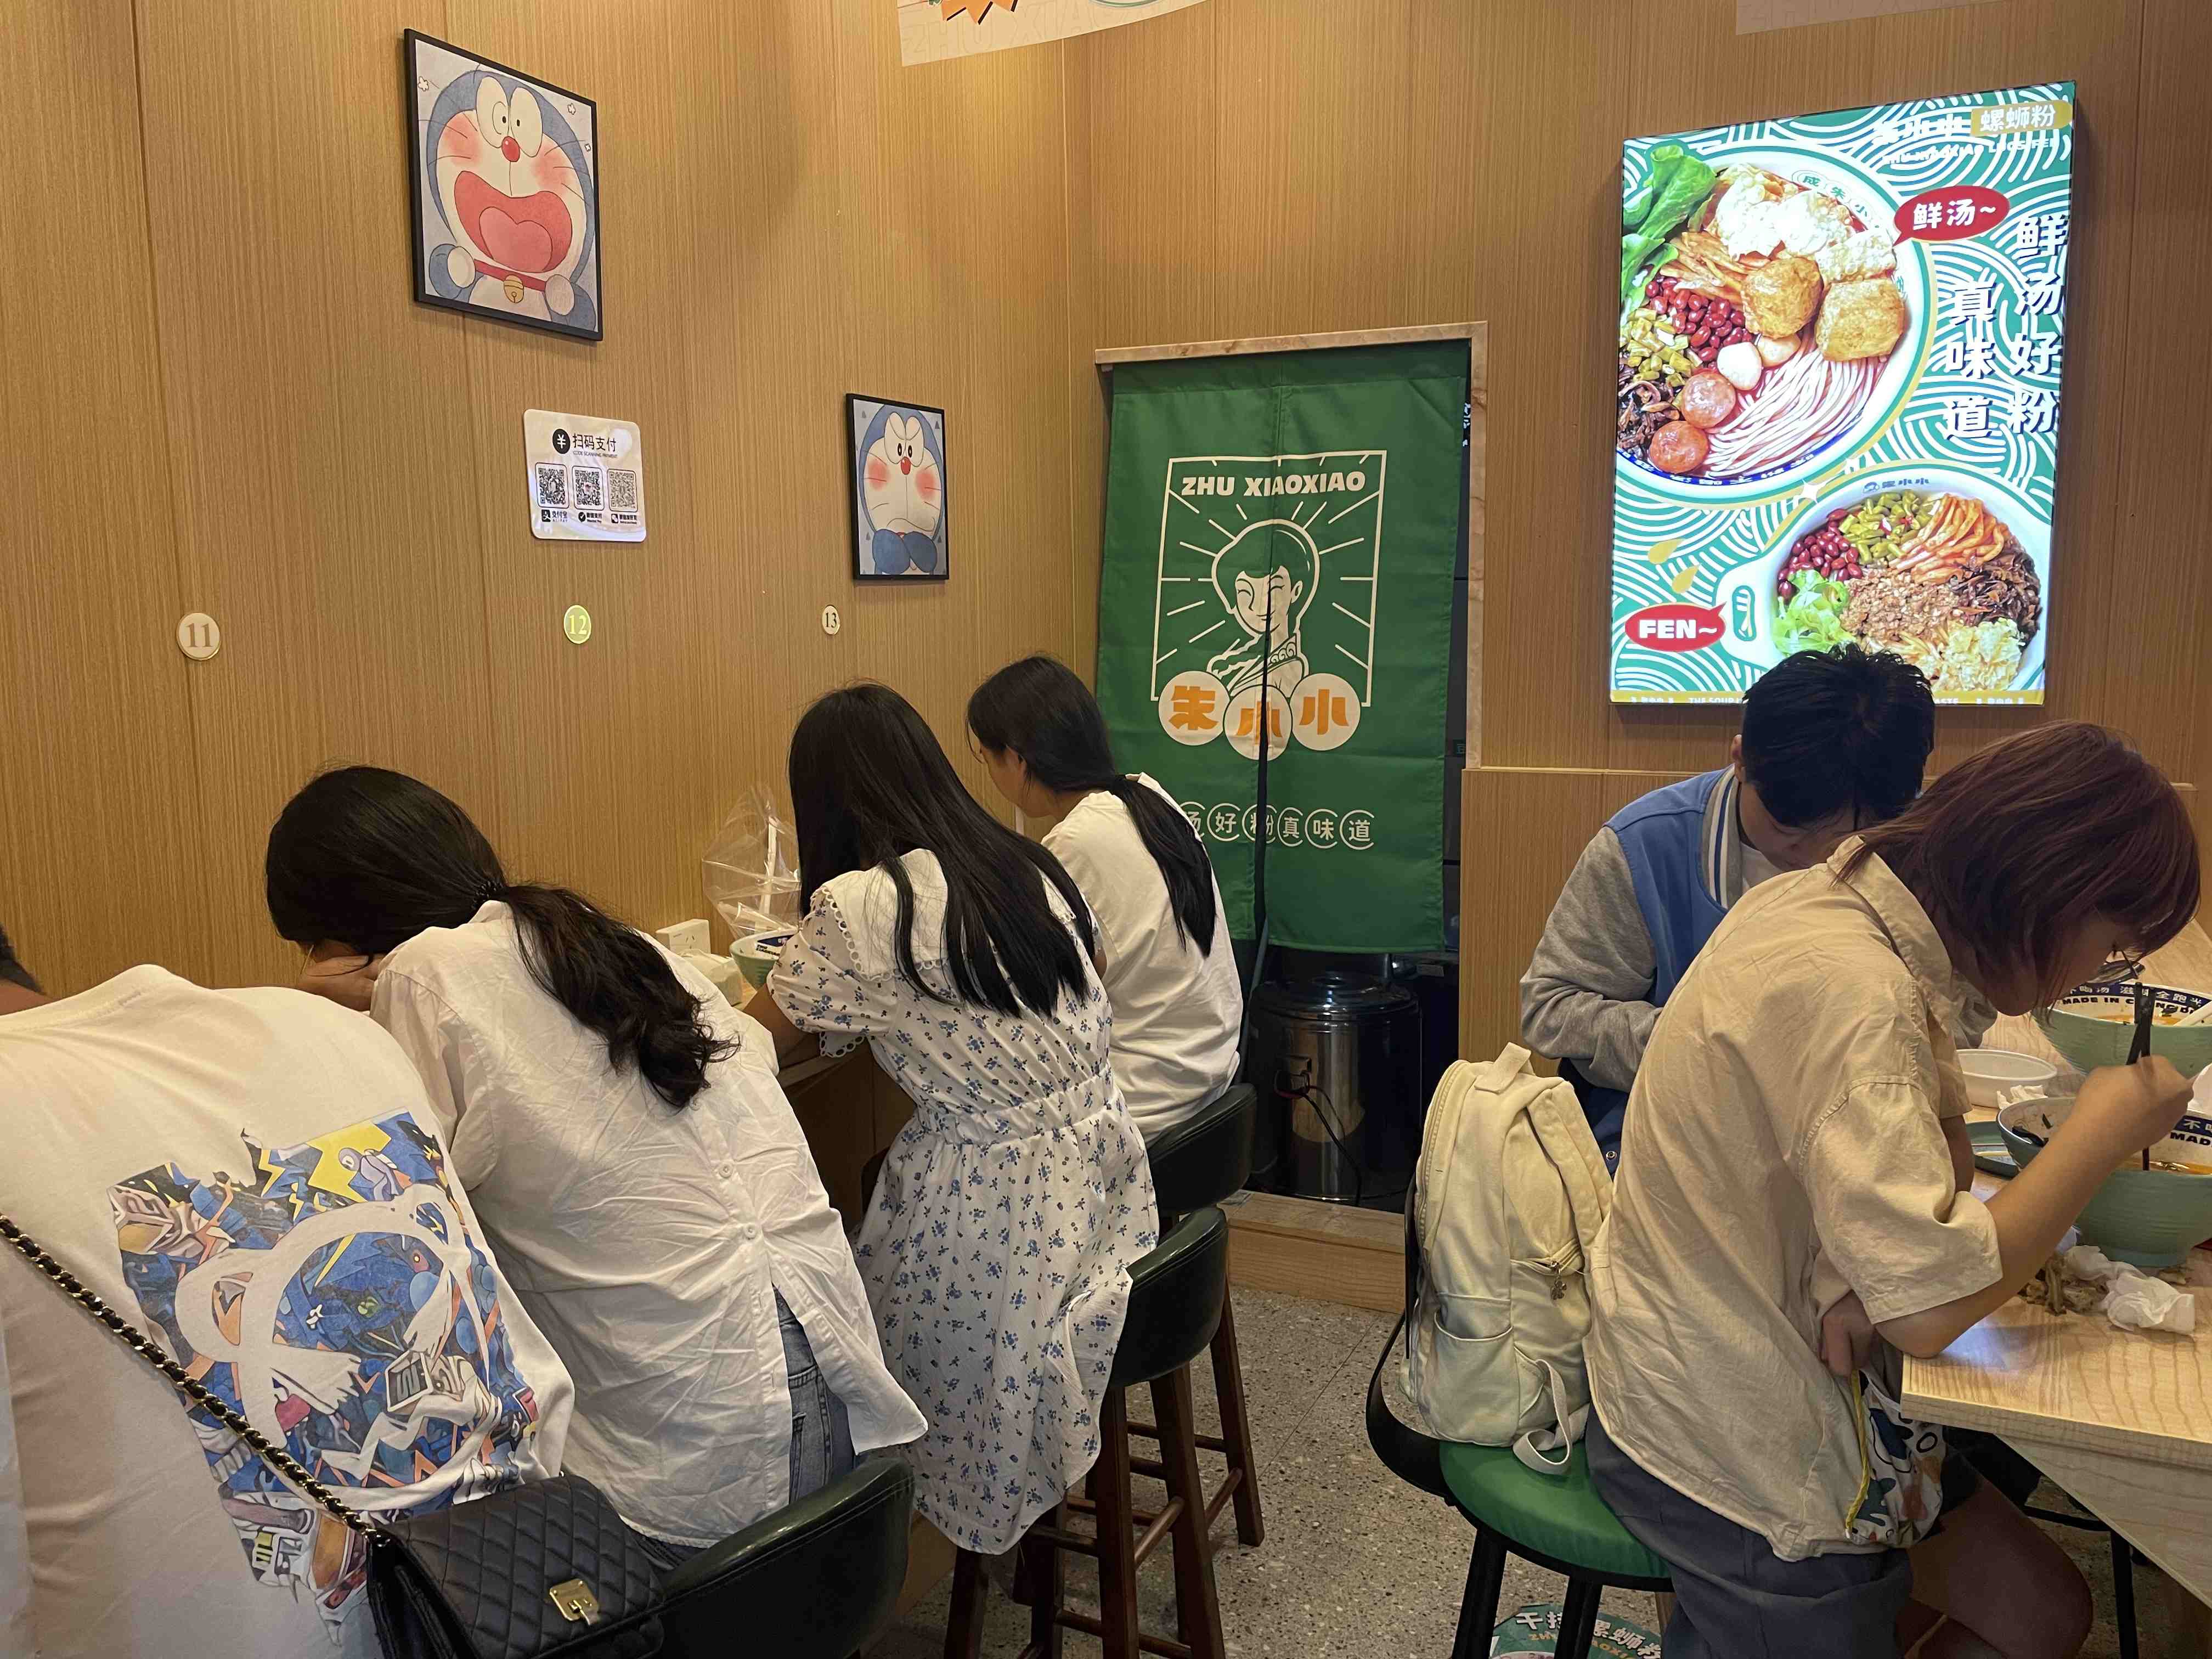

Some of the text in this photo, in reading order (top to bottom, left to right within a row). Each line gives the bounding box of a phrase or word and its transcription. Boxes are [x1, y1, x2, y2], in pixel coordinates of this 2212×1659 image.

[1980, 104, 2056, 132] 螺蛳粉
[2009, 215, 2069, 435] 鲜汤好粉
[1944, 280, 1996, 440] 真味道
[572, 433, 616, 452] 扫码支付
[1182, 471, 1365, 496] ZHU XIAOXIAO
[569, 614, 587, 635] 12
[826, 612, 837, 628] 13
[185, 623, 213, 647] 11
[1168, 685, 1349, 745] 朱小小
[2062, 997, 2098, 1005] MADE
[2170, 1132, 2212, 1148] MAD
